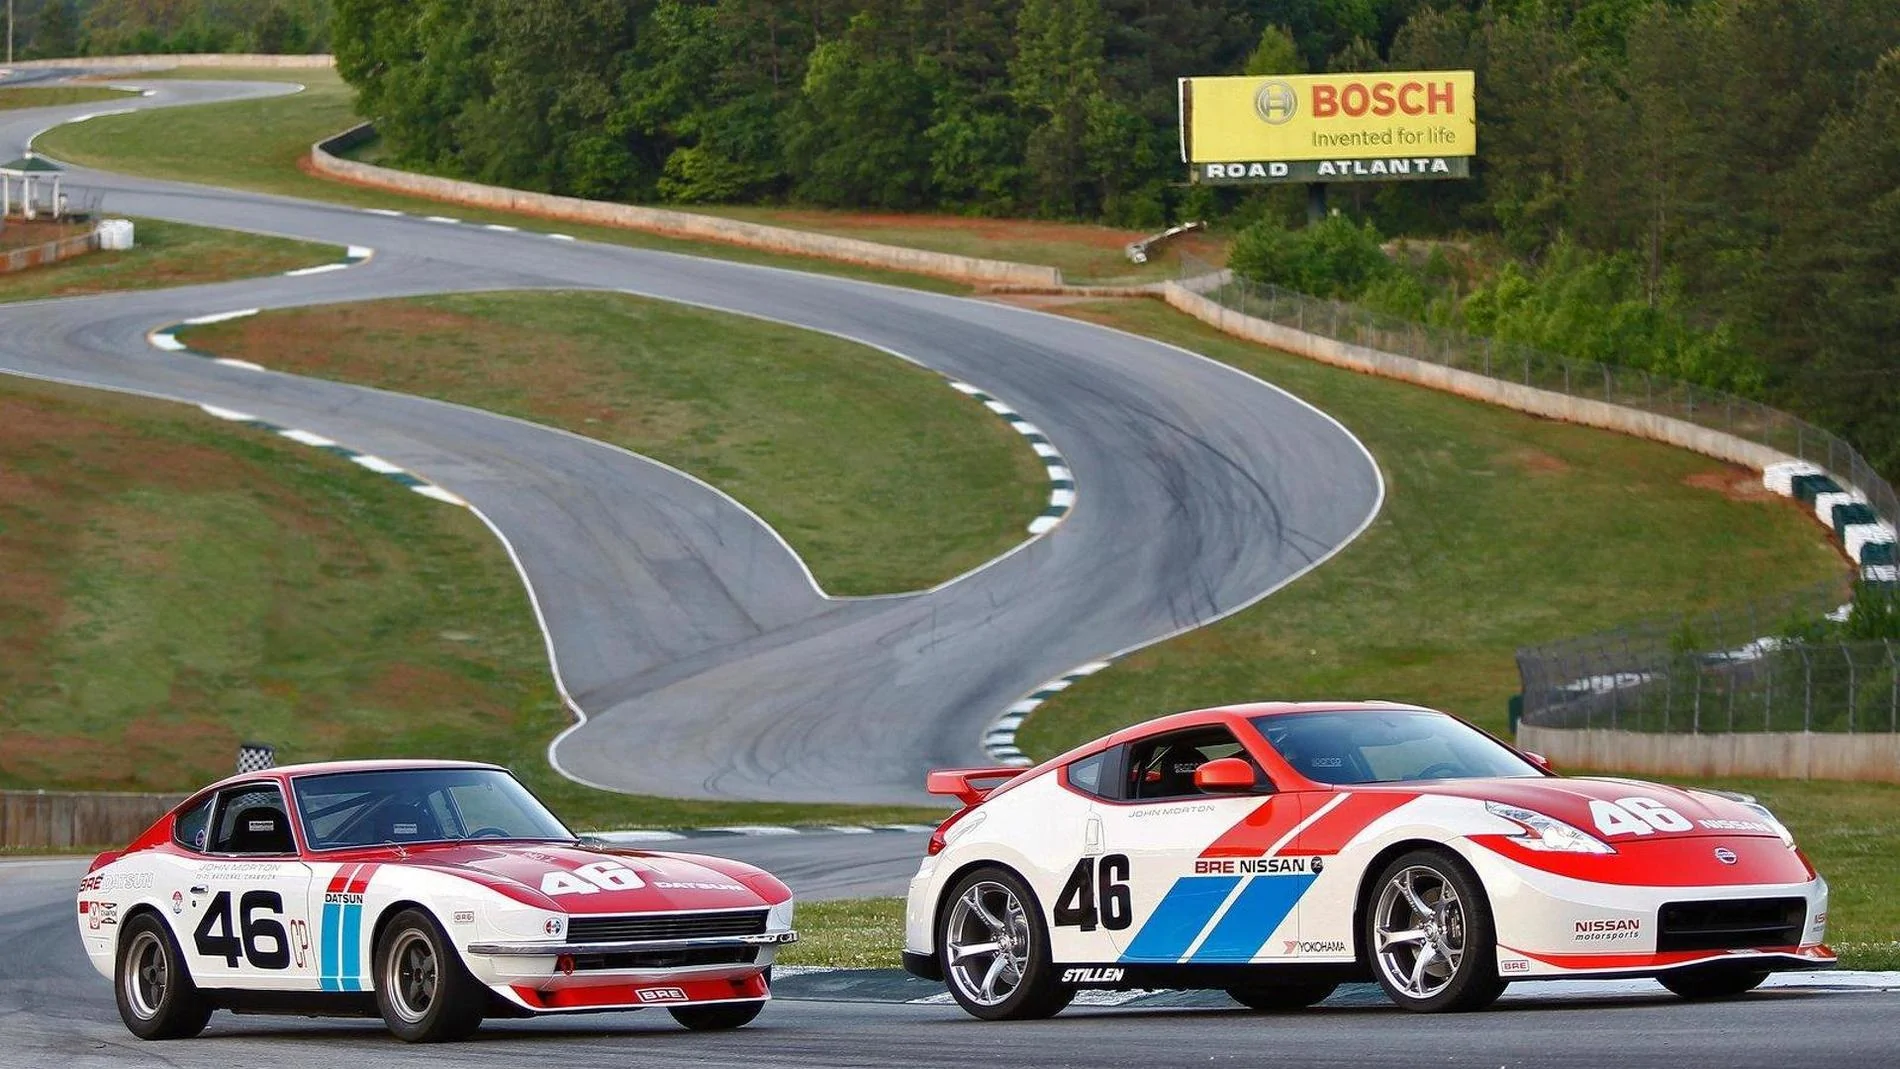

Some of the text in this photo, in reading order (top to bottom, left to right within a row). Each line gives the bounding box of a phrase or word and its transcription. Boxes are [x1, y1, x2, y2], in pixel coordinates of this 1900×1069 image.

[1312, 82, 1455, 118] BOSCH
[1312, 126, 1456, 147] Invented for life
[1206, 158, 1449, 178] ROAD ATLANTA
[1128, 809, 1161, 818] JOHN
[1589, 797, 1694, 836] 46
[1195, 859, 1305, 873] BRE NISSAN
[540, 861, 646, 896] 46
[653, 882, 746, 891] DATSUN
[1053, 853, 1133, 932] 46
[325, 893, 363, 904] DATSUN
[193, 890, 291, 969] 46
[1575, 920, 1640, 932] NISSAN
[1575, 931, 1640, 941] motorsports
[290, 919, 309, 968] CP
[1300, 941, 1347, 953] YOKOHAMA
[1061, 968, 1125, 982] STILLEN
[641, 990, 682, 1000] BRE
